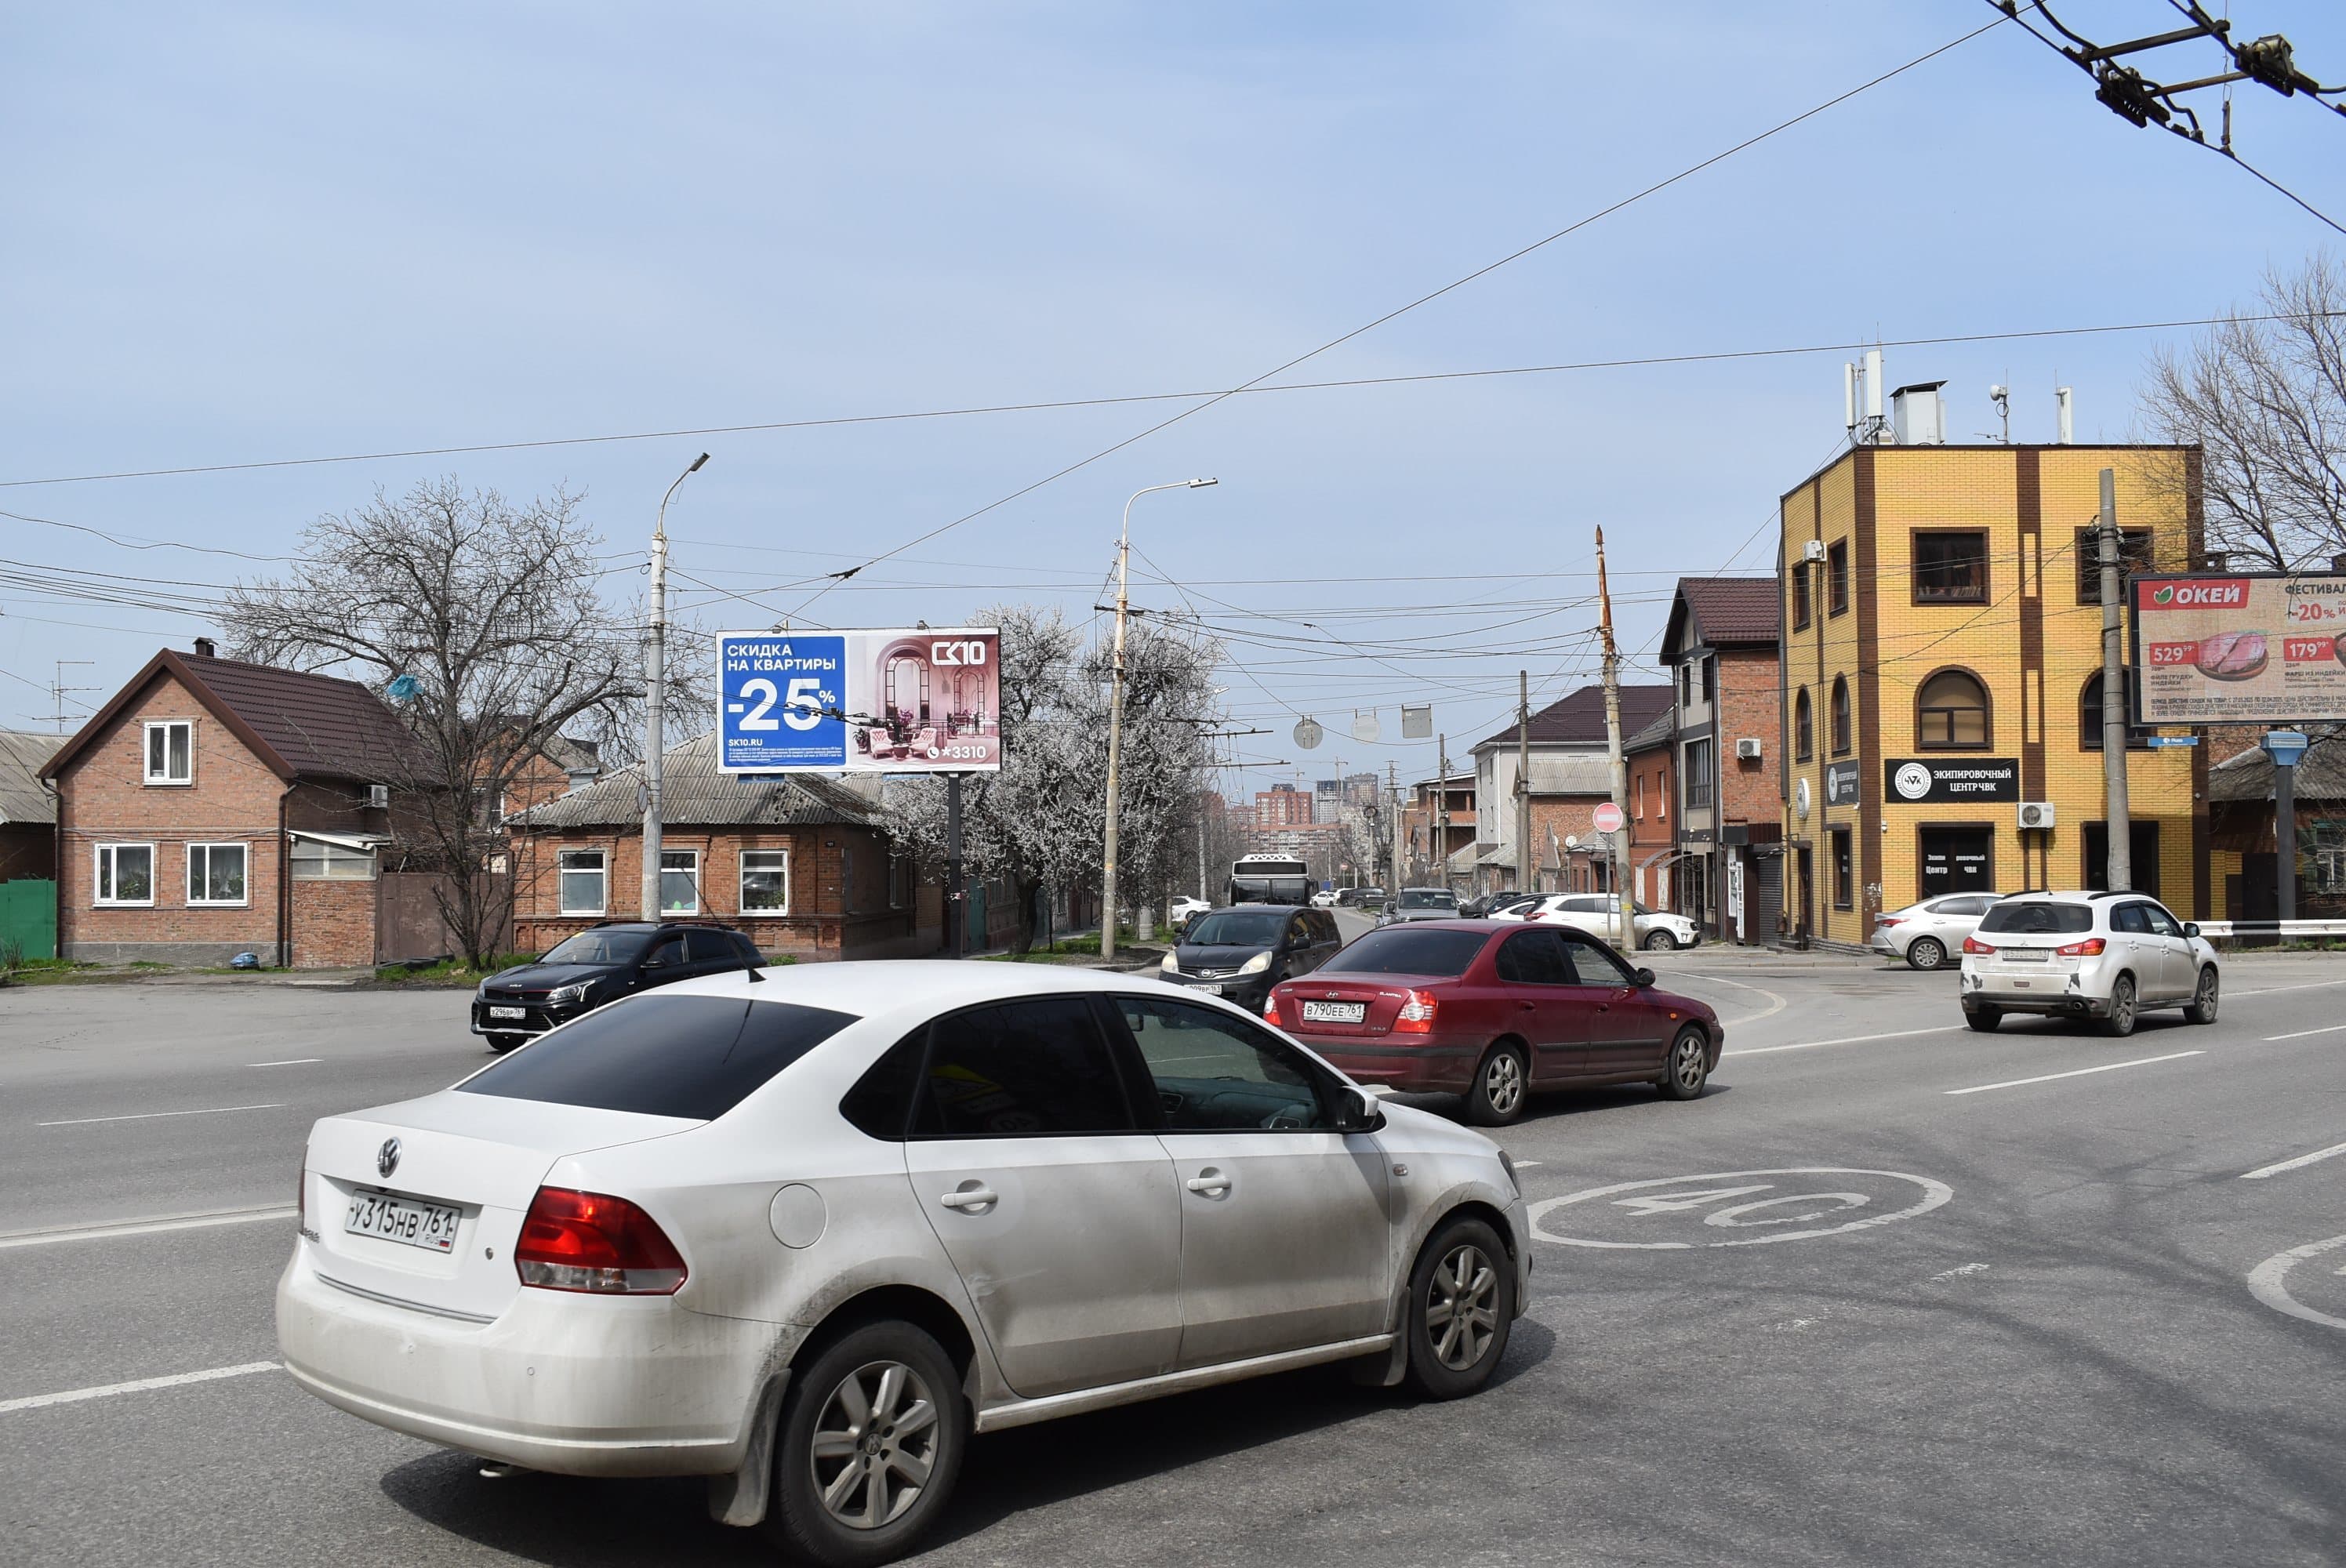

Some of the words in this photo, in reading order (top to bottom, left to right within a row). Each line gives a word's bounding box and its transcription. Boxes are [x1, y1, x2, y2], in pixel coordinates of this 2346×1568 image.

[728, 644, 792, 658] СКИДКА
[728, 659, 749, 671] НА
[754, 659, 836, 670] КВАРТИРЫ
[1934, 768, 2011, 779] ЭКИПИРОВОЧНЫЙ
[1950, 782, 1977, 792] ЦЕНТР
[1979, 782, 1996, 791] ЧВК
[352, 1197, 419, 1239] У315НВ
[422, 1207, 452, 1236] 761
